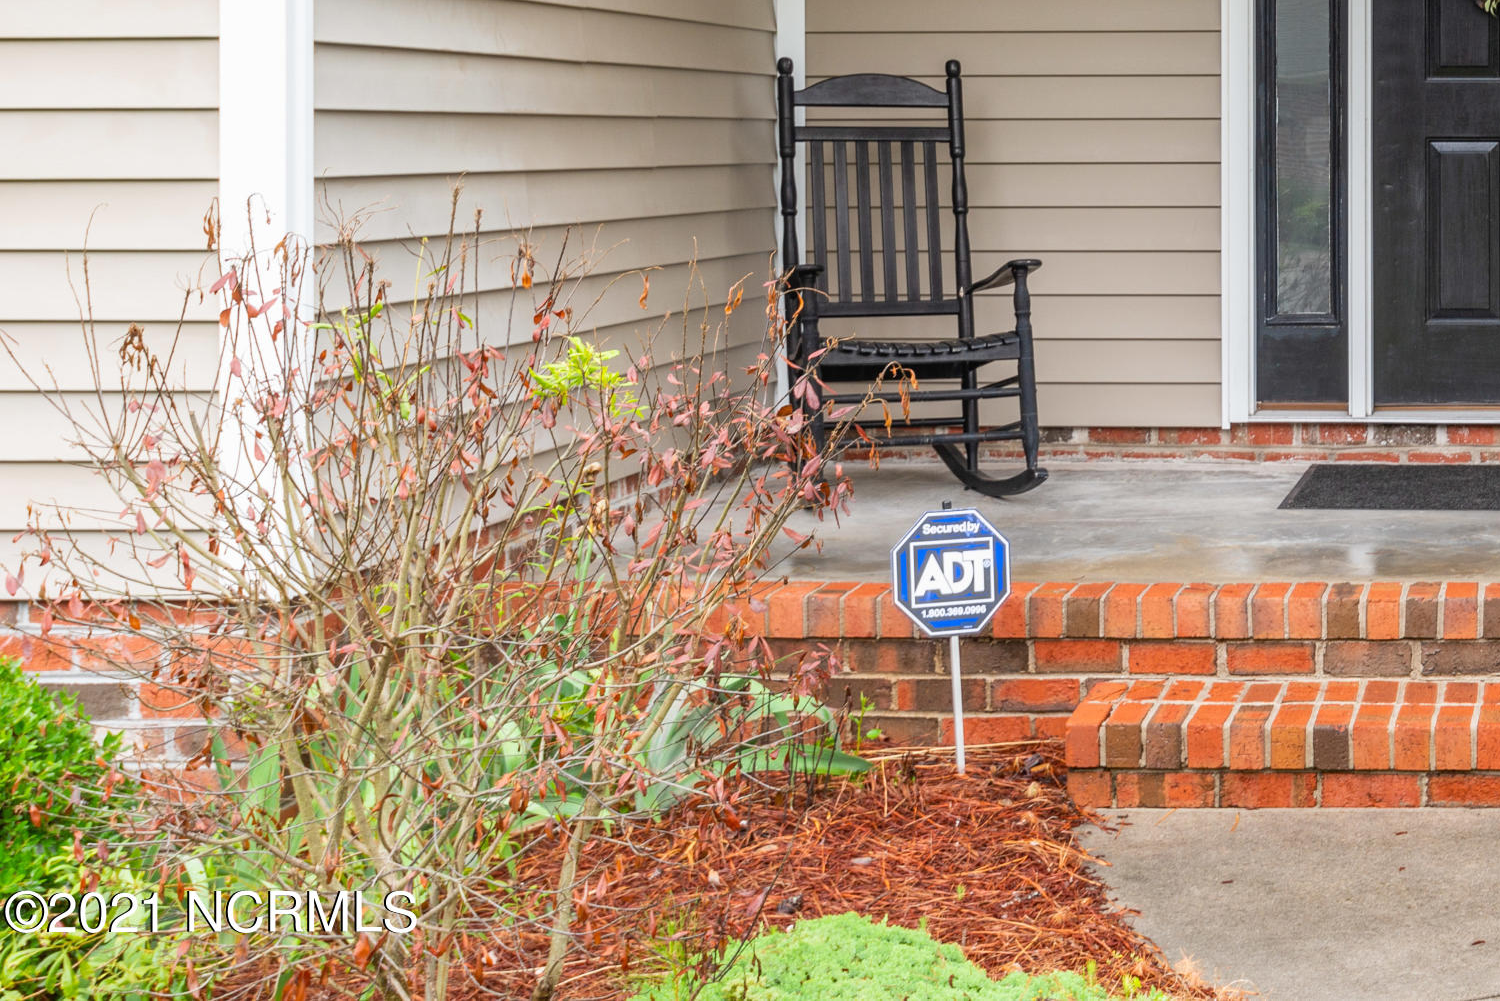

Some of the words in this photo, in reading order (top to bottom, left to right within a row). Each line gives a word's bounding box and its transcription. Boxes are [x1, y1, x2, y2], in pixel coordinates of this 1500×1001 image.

[922, 521, 966, 535] Secured
[967, 521, 981, 533] by
[914, 548, 991, 597] ADT
